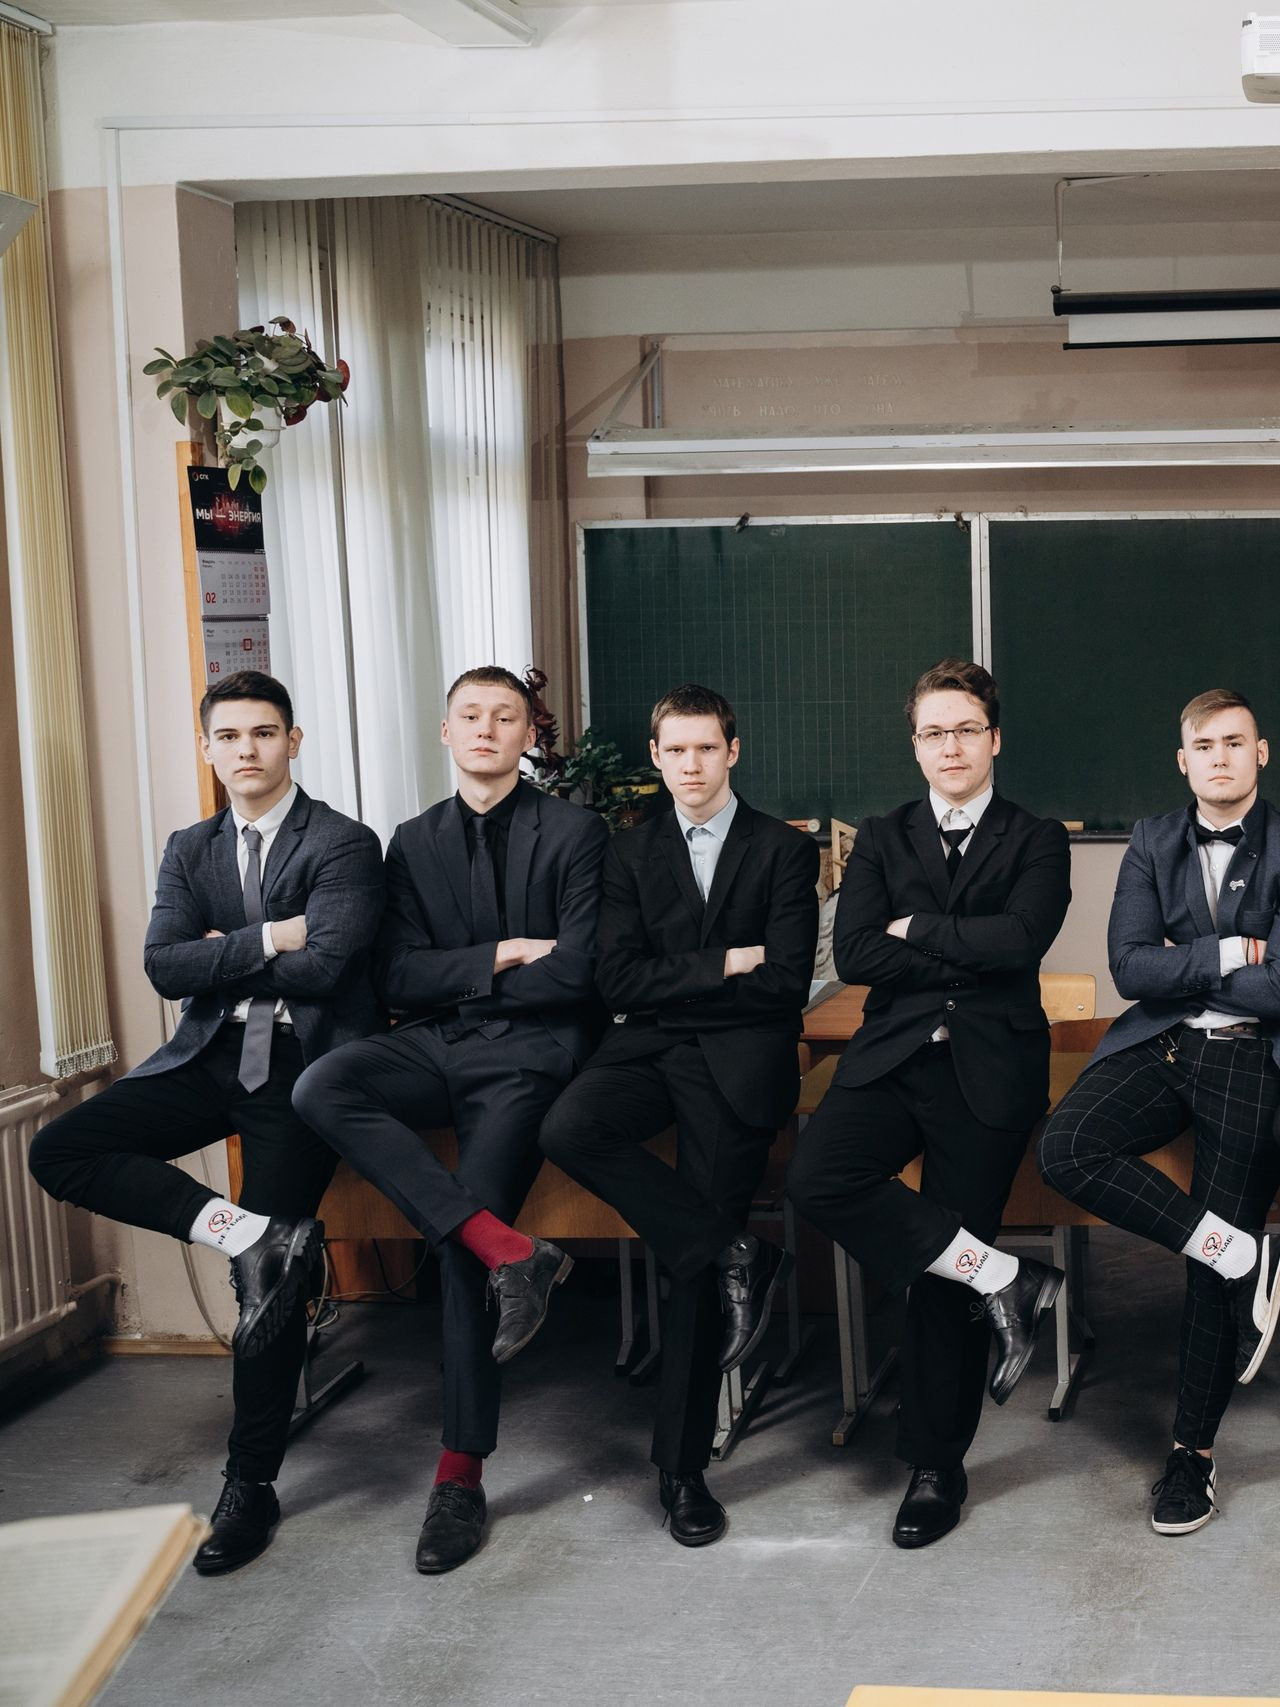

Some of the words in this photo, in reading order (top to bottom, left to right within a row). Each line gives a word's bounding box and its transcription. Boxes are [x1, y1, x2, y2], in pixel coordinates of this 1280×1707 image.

[195, 508, 213, 520] МЫ
[228, 510, 262, 523] ЭНЕРГИЯ
[205, 592, 216, 604] 02
[210, 661, 220, 673] 03
